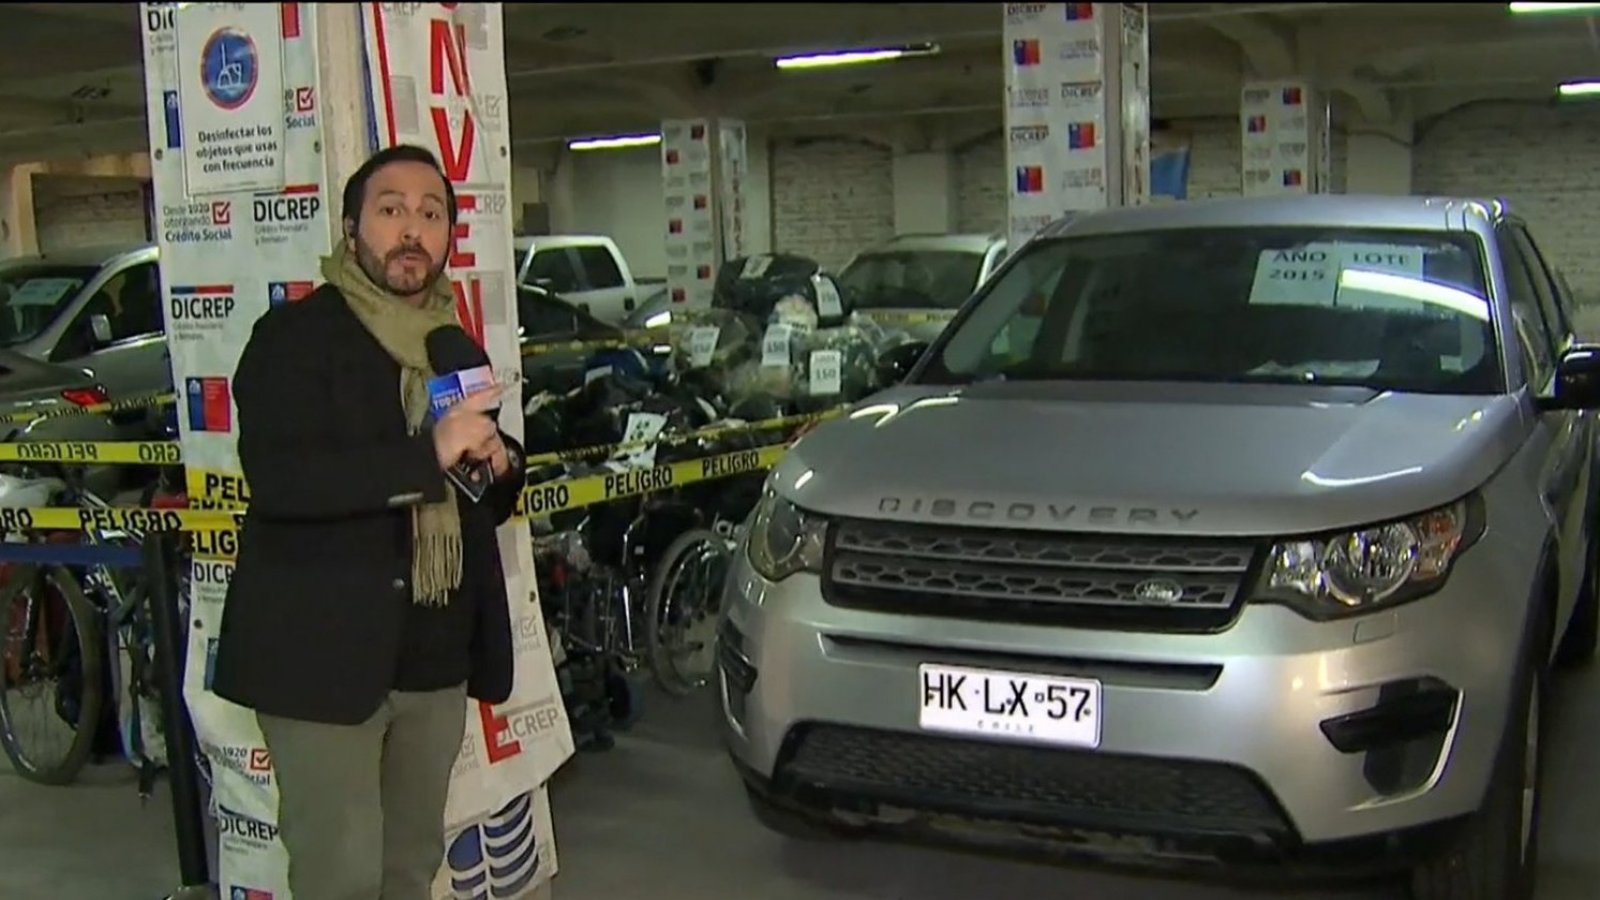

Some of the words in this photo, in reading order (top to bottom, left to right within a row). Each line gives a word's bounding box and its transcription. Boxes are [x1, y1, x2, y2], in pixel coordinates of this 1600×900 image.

[285, 114, 315, 129] Social
[198, 127, 254, 143] Desinfectar
[257, 125, 272, 136] los
[196, 145, 232, 160] objetos
[234, 144, 252, 157] que
[255, 141, 277, 152] usas
[203, 163, 221, 173] con
[223, 154, 274, 172] frecuencia
[253, 196, 320, 222] DICREP
[203, 227, 232, 241] Social
[1269, 268, 1325, 281] 2015
[171, 296, 235, 320] DICREP
[605, 466, 673, 498] PELIGRO
[702, 451, 760, 477] PELIGRO
[0, 507, 33, 533] RO
[79, 508, 182, 533] PELIGRO
[878, 497, 1198, 526] DISCOVERY
